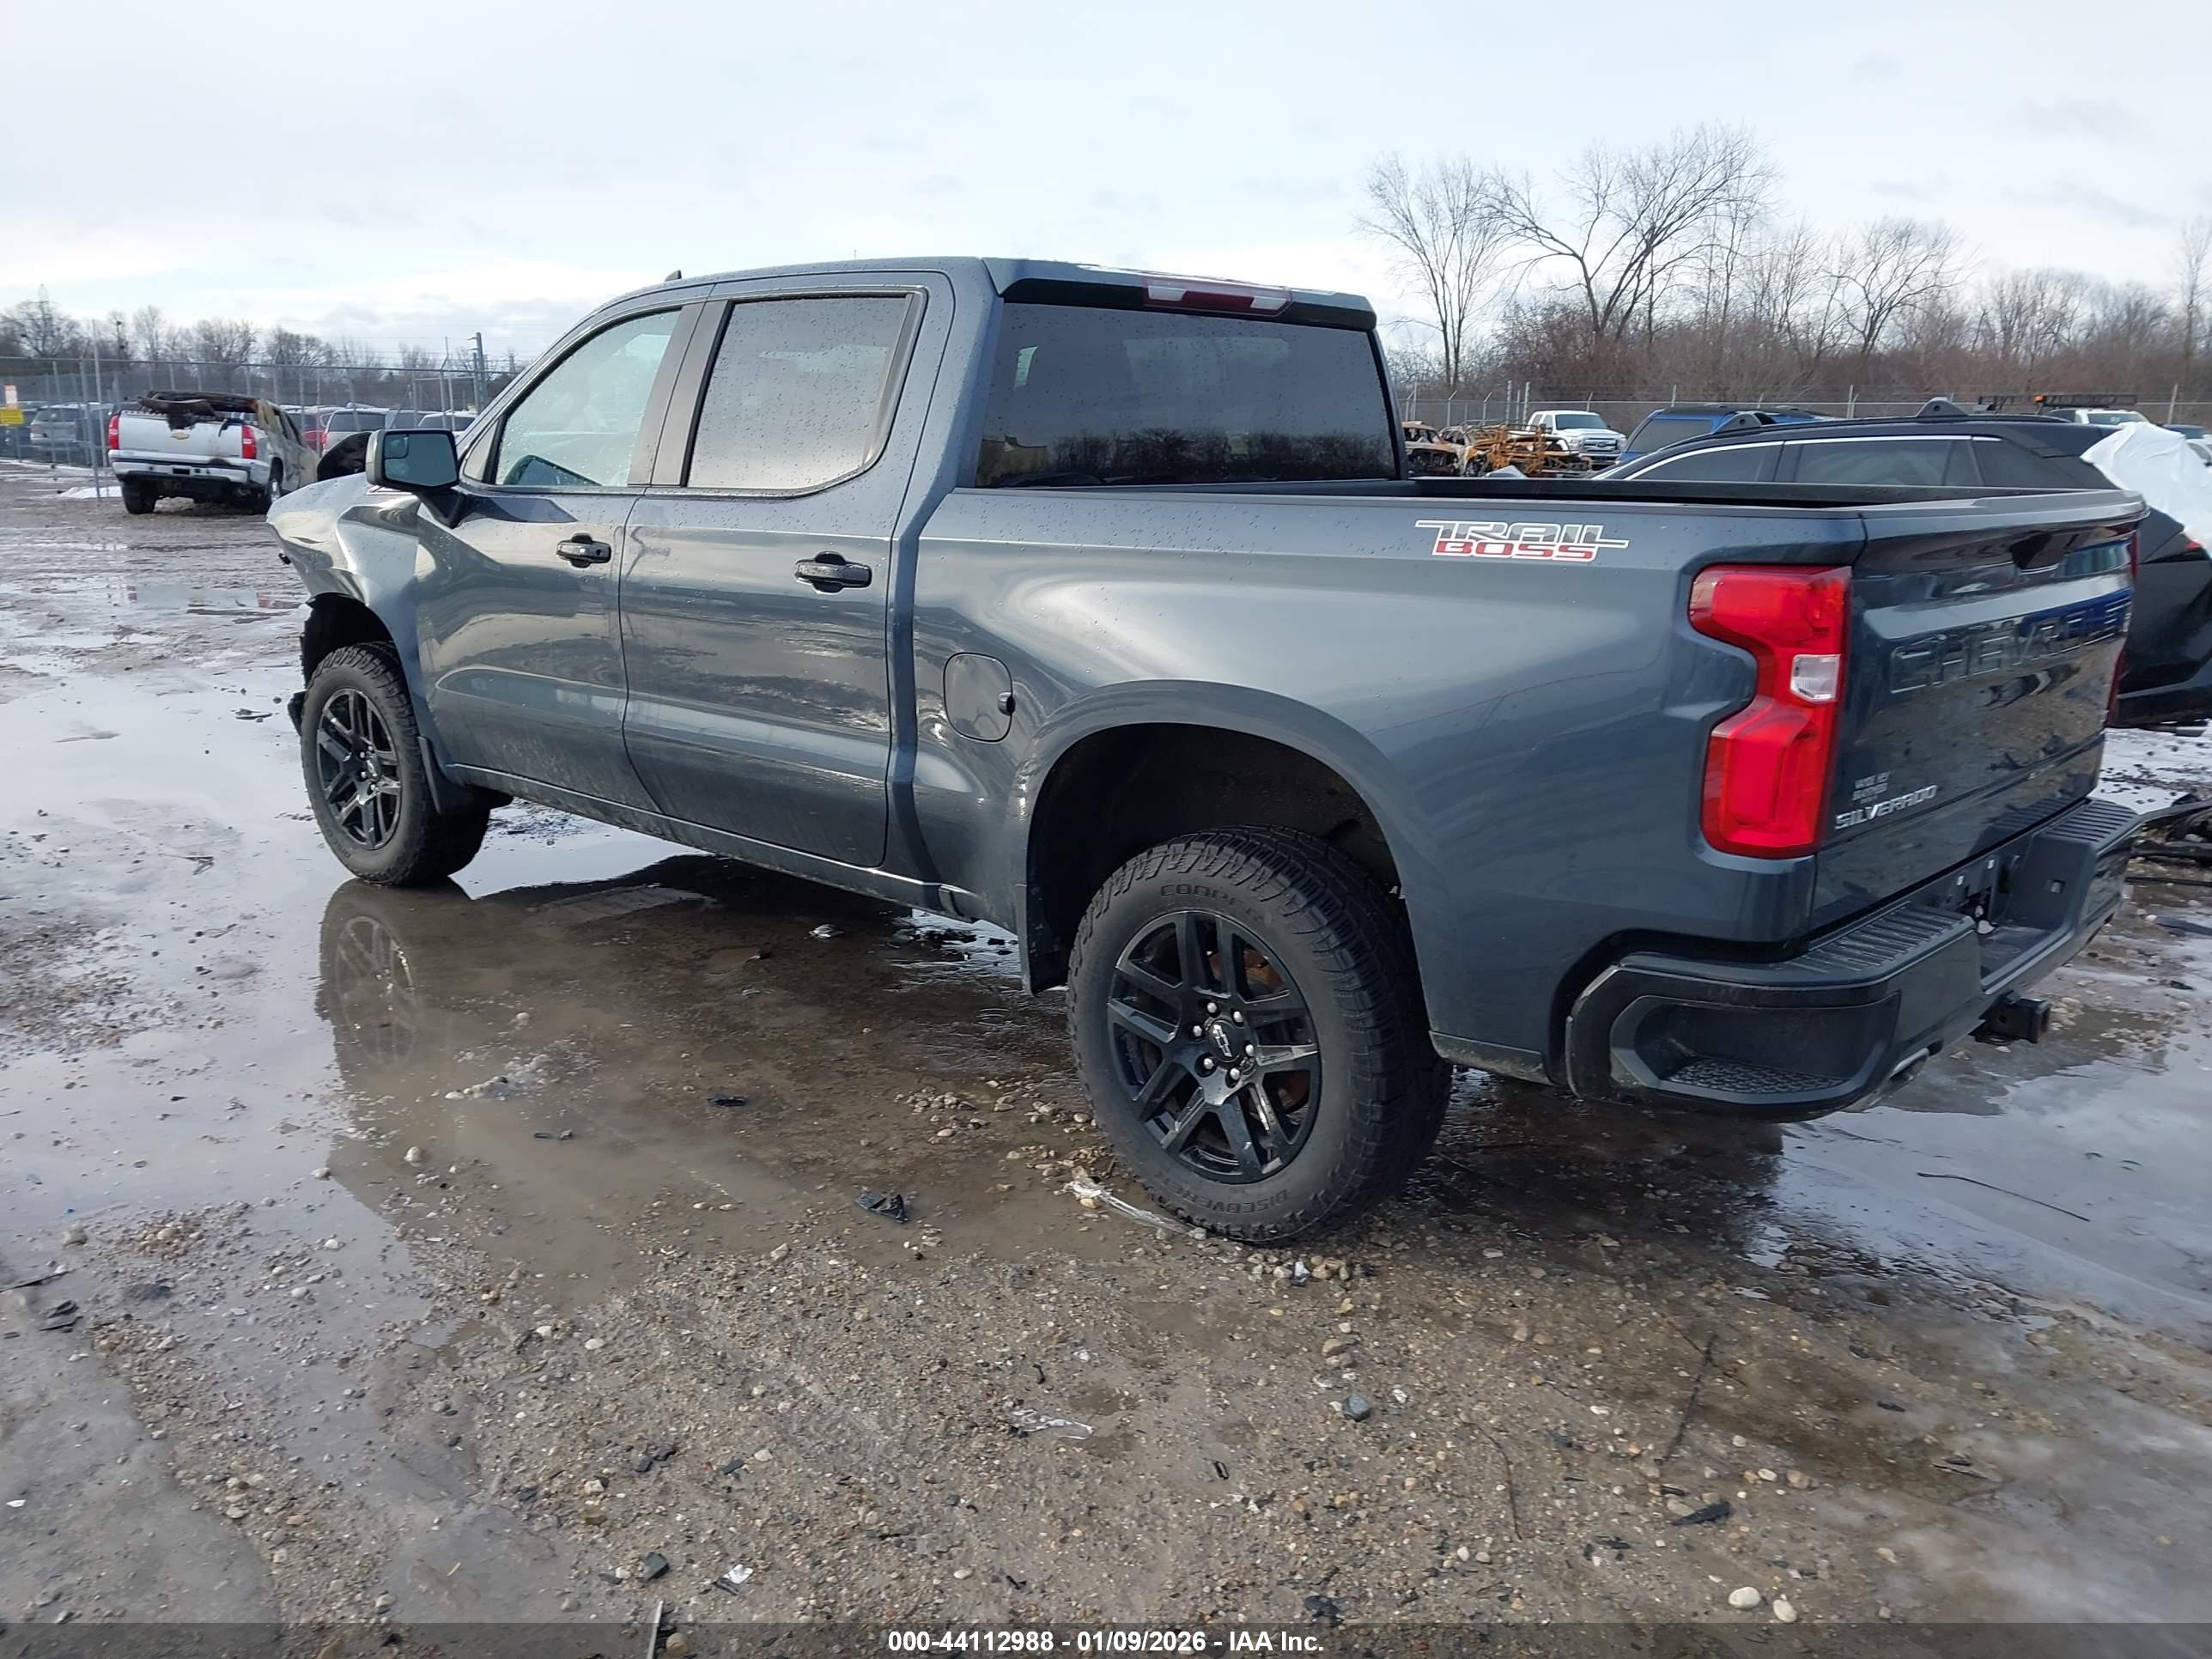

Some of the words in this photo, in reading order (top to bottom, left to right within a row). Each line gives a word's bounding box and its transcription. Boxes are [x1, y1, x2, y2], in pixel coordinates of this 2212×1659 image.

[1415, 520, 1630, 549] TRAIL
[1431, 539, 1598, 562] BOSS
[1834, 784, 1938, 830] SILVERADO
